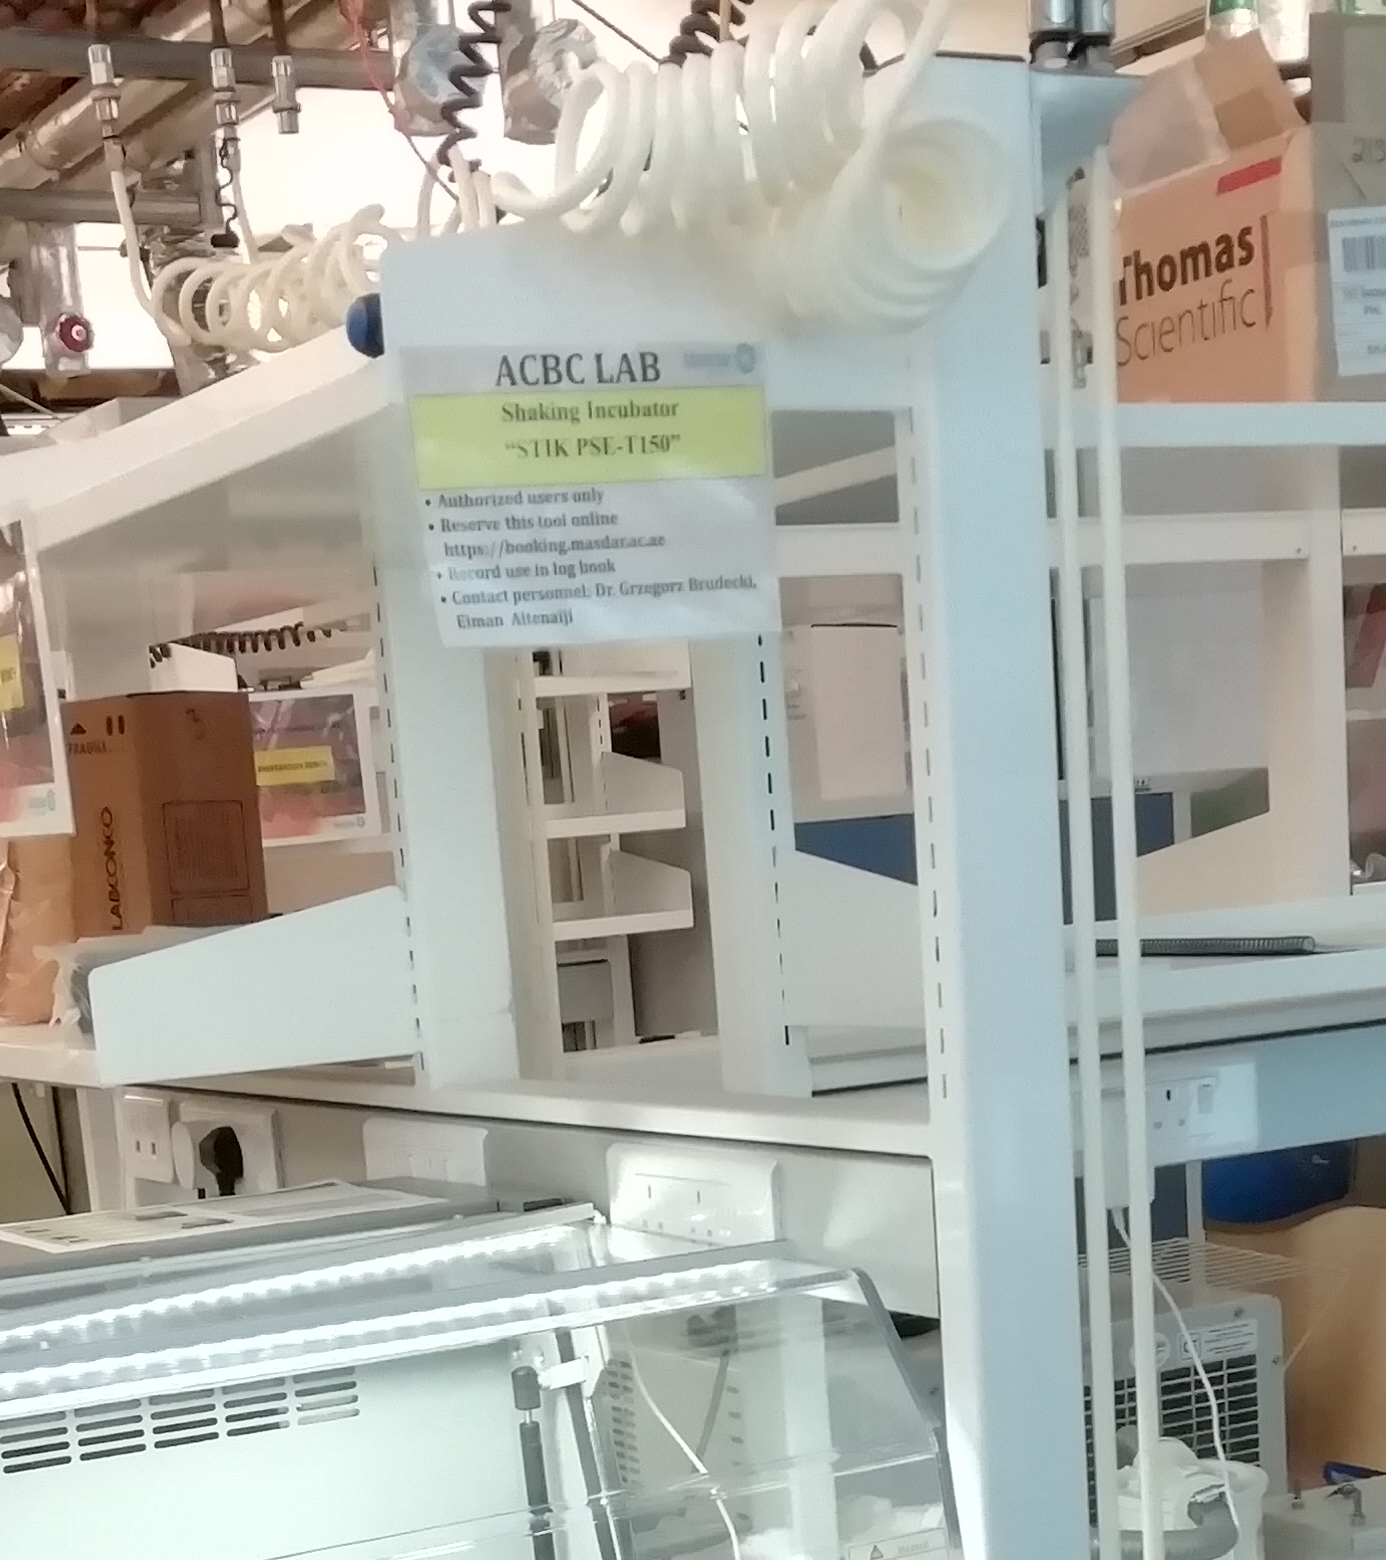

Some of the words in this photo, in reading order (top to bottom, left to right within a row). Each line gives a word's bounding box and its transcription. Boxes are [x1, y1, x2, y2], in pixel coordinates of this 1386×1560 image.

[1116, 278, 1257, 367] Scientific
[495, 353, 586, 387] ACBC
[594, 351, 661, 385] LAB
[501, 402, 581, 426] Shaking
[587, 399, 680, 420] Incubator
[438, 490, 524, 508] Authorized
[527, 491, 569, 505] users
[573, 487, 605, 506] only
[441, 518, 501, 533] Reserve
[505, 515, 535, 531] this
[538, 513, 568, 528] tool
[571, 510, 619, 527] online
[448, 564, 502, 581] Record
[505, 565, 531, 578] use
[535, 563, 550, 577] in
[553, 561, 577, 580] log
[579, 558, 616, 575] book
[452, 589, 509, 606] Contact
[620, 579, 685, 598] Grzegorz
